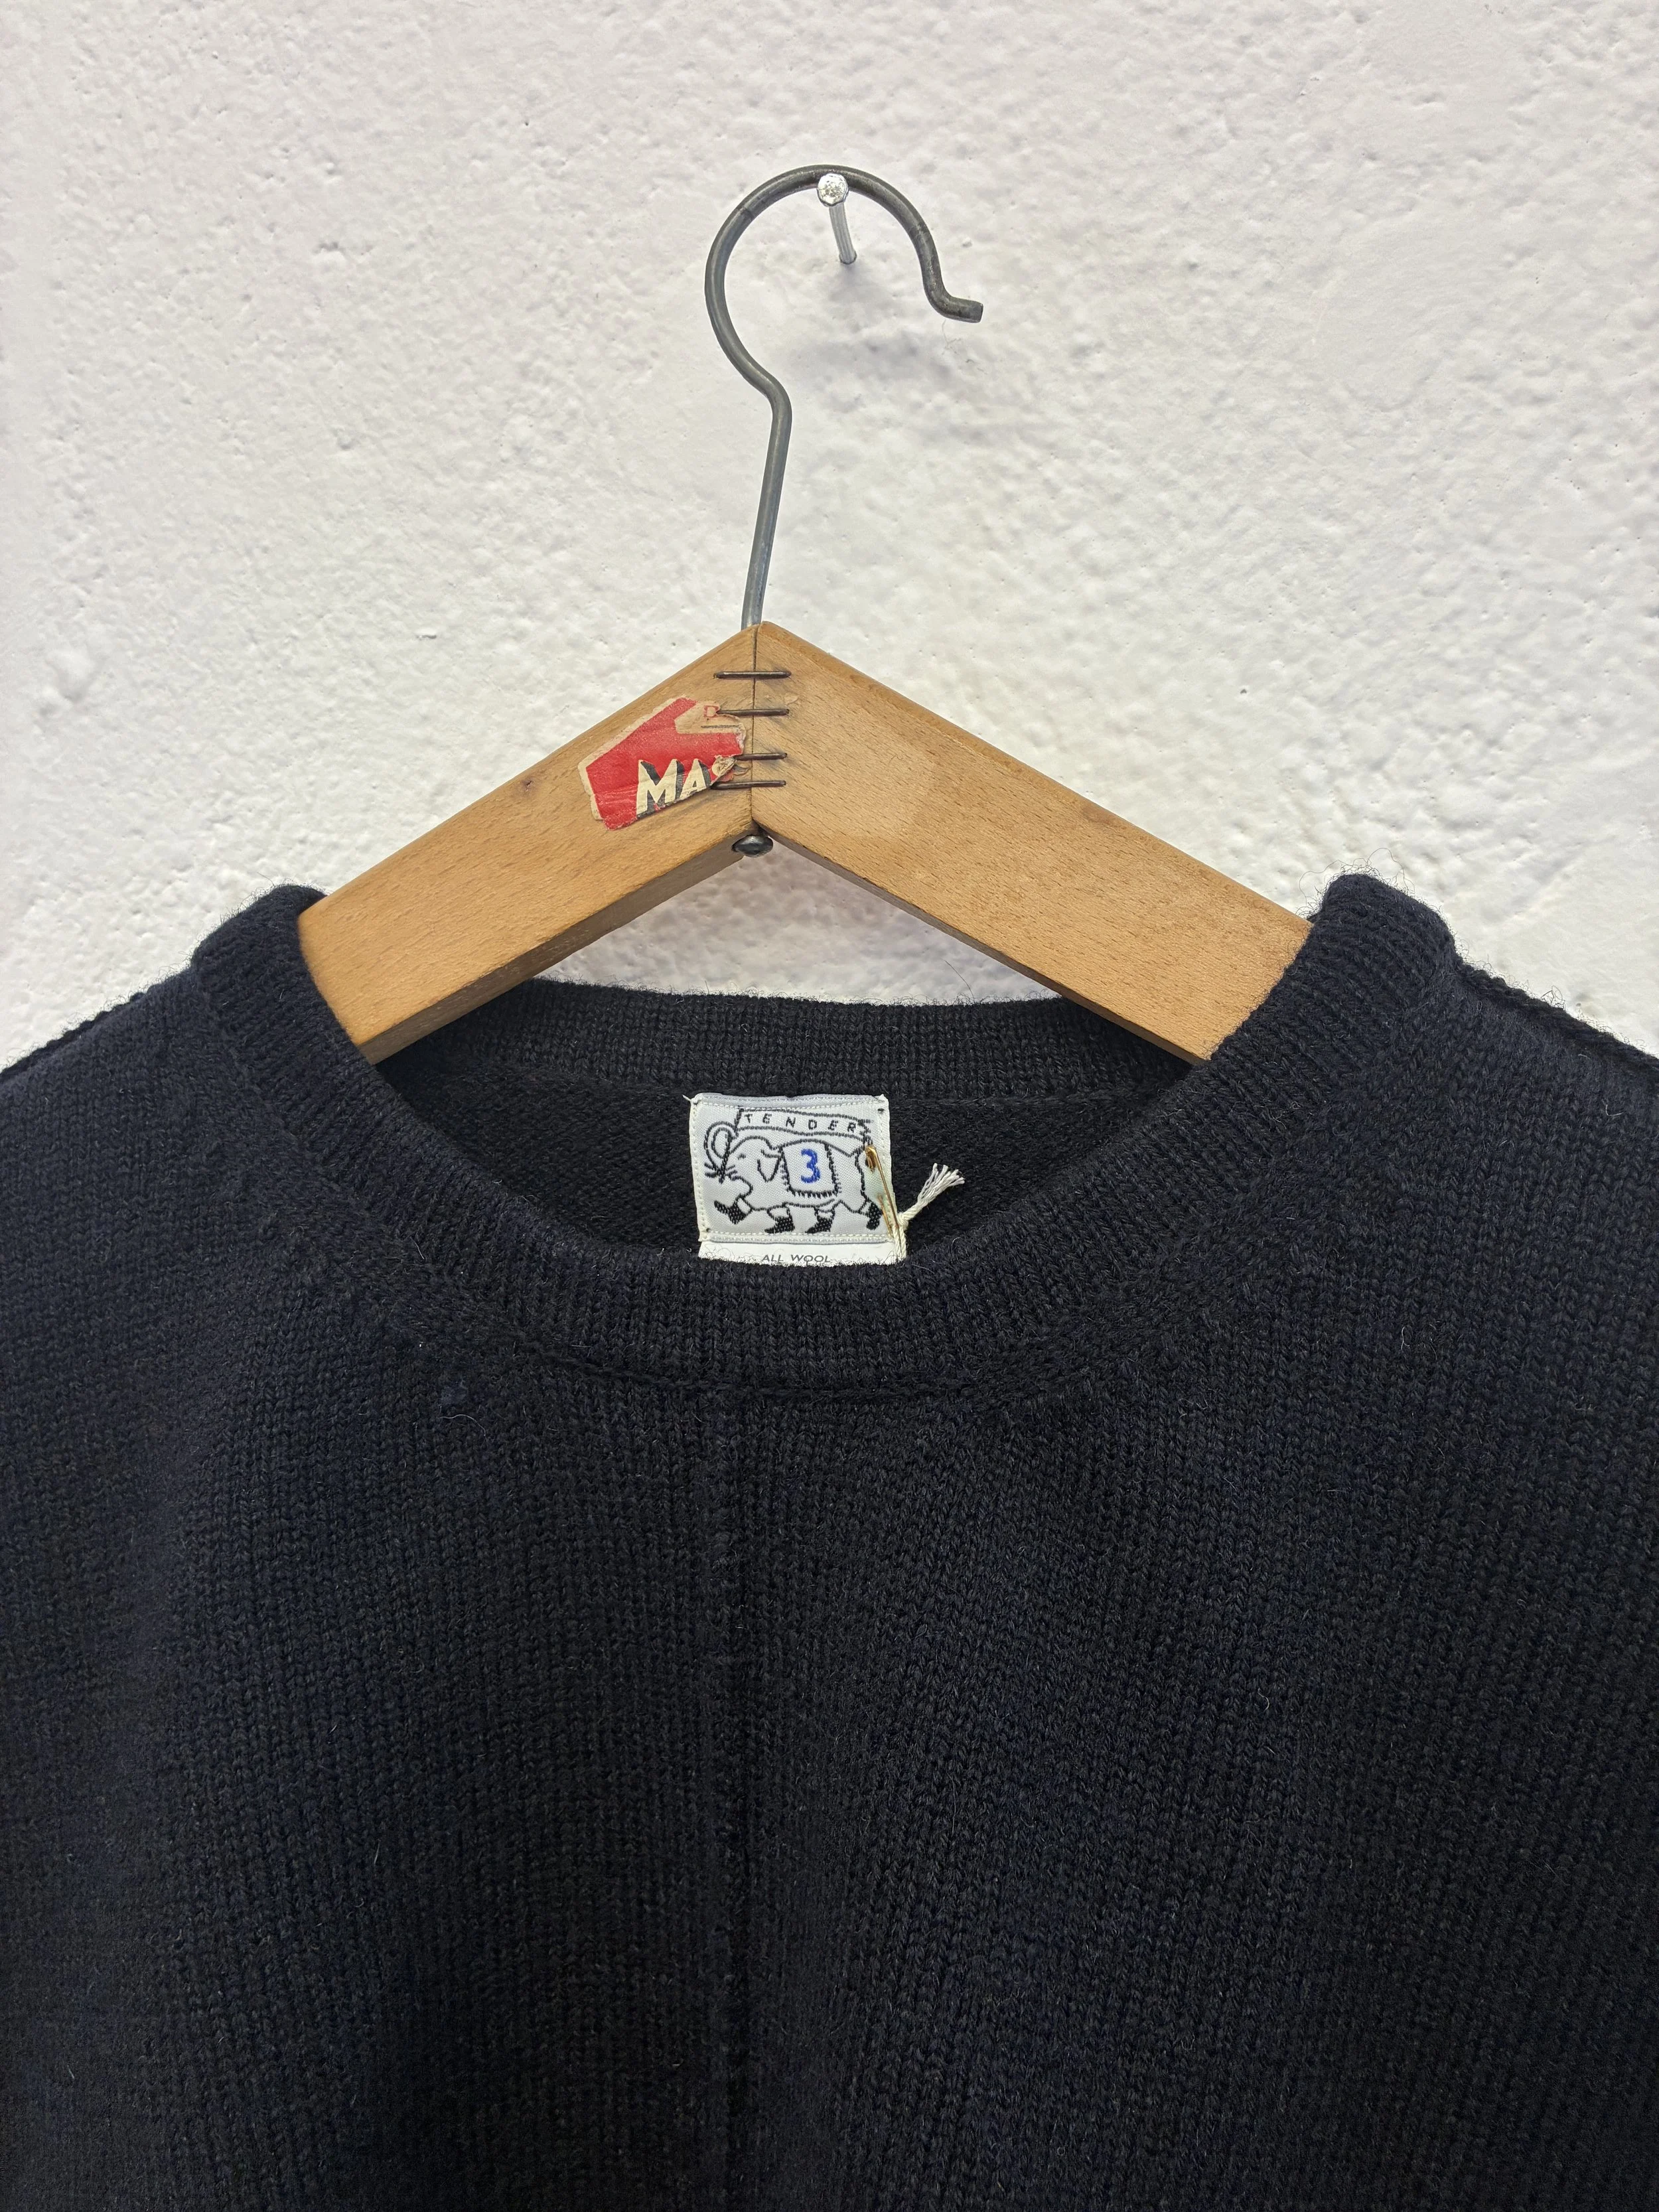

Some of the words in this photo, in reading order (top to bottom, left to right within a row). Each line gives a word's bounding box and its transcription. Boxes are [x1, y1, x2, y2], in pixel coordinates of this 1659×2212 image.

[744, 1113, 857, 1133] TENDER
[800, 1148, 821, 1184] 3
[790, 1254, 830, 1263] WOOL
